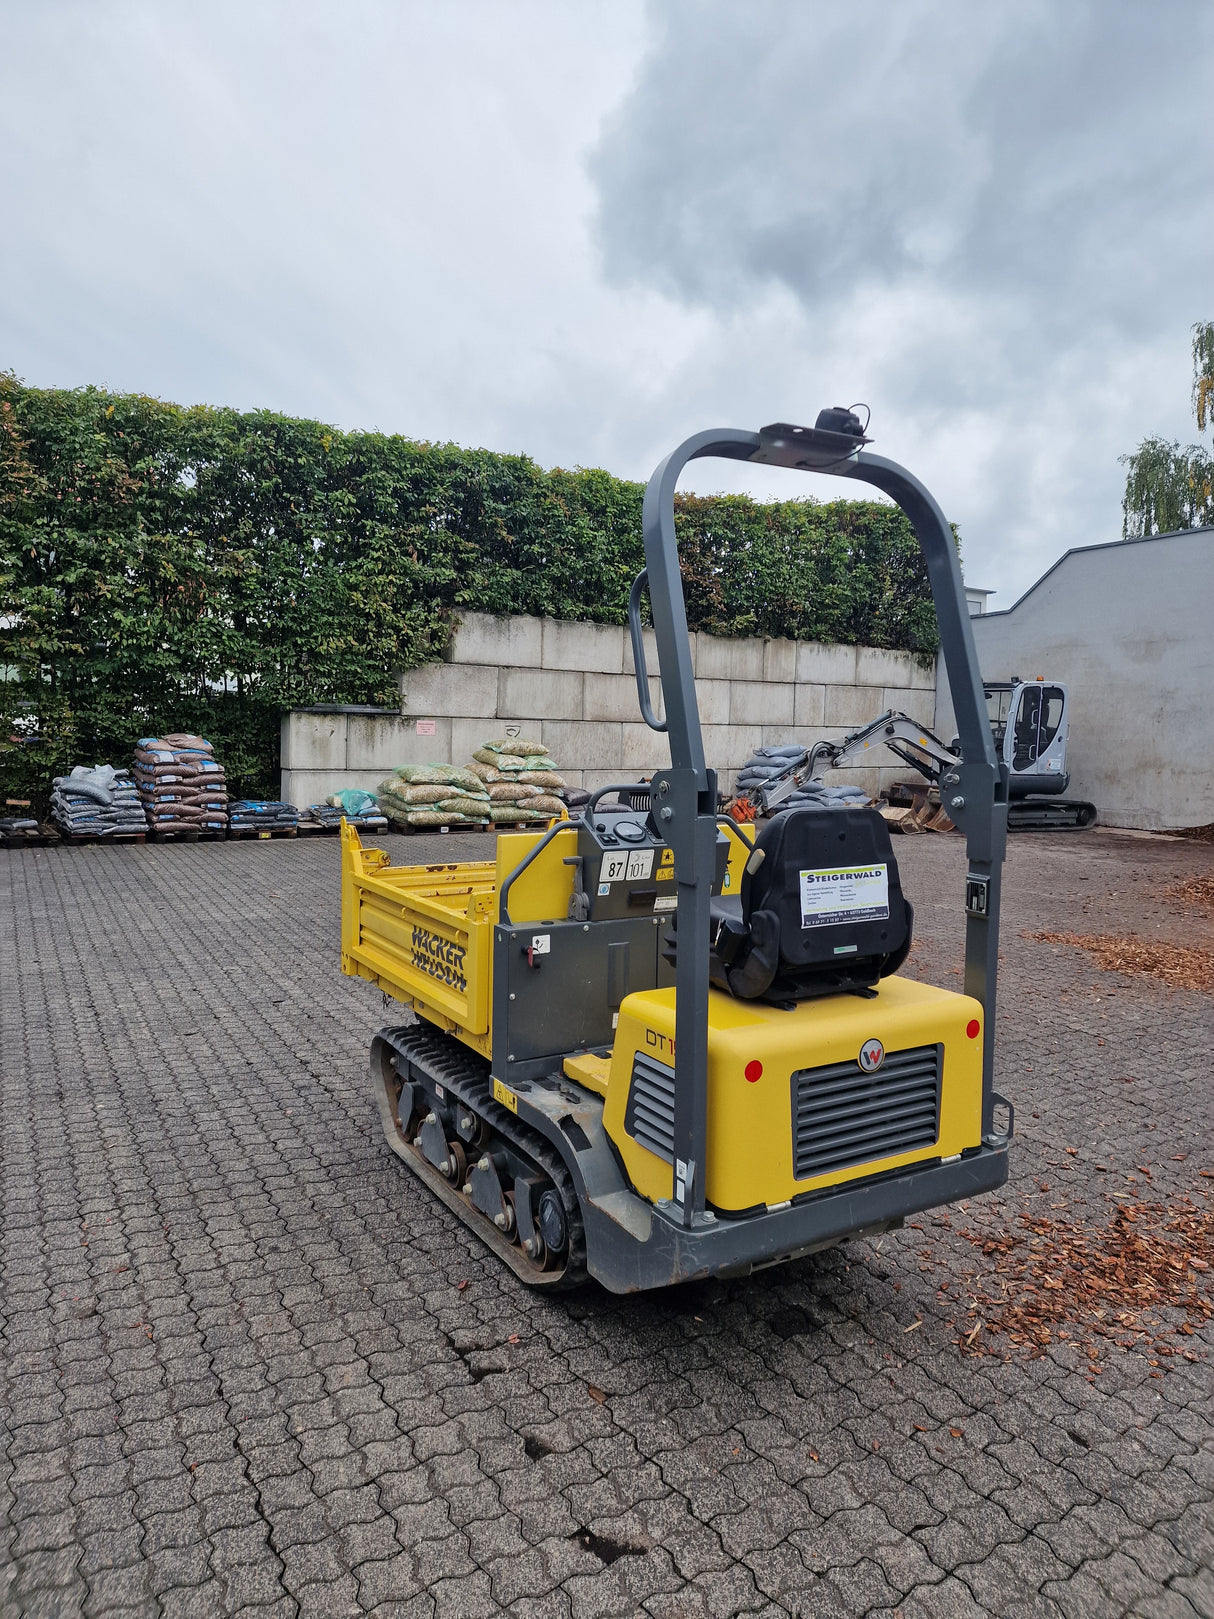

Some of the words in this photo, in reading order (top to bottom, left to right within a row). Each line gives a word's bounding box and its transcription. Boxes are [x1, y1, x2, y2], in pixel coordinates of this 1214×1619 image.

[608, 862, 624, 877] 87
[630, 863, 644, 877] 101
[806, 871, 882, 883] STEIGERWALD
[412, 925, 466, 970] WACKER
[411, 947, 467, 992] NEUSON
